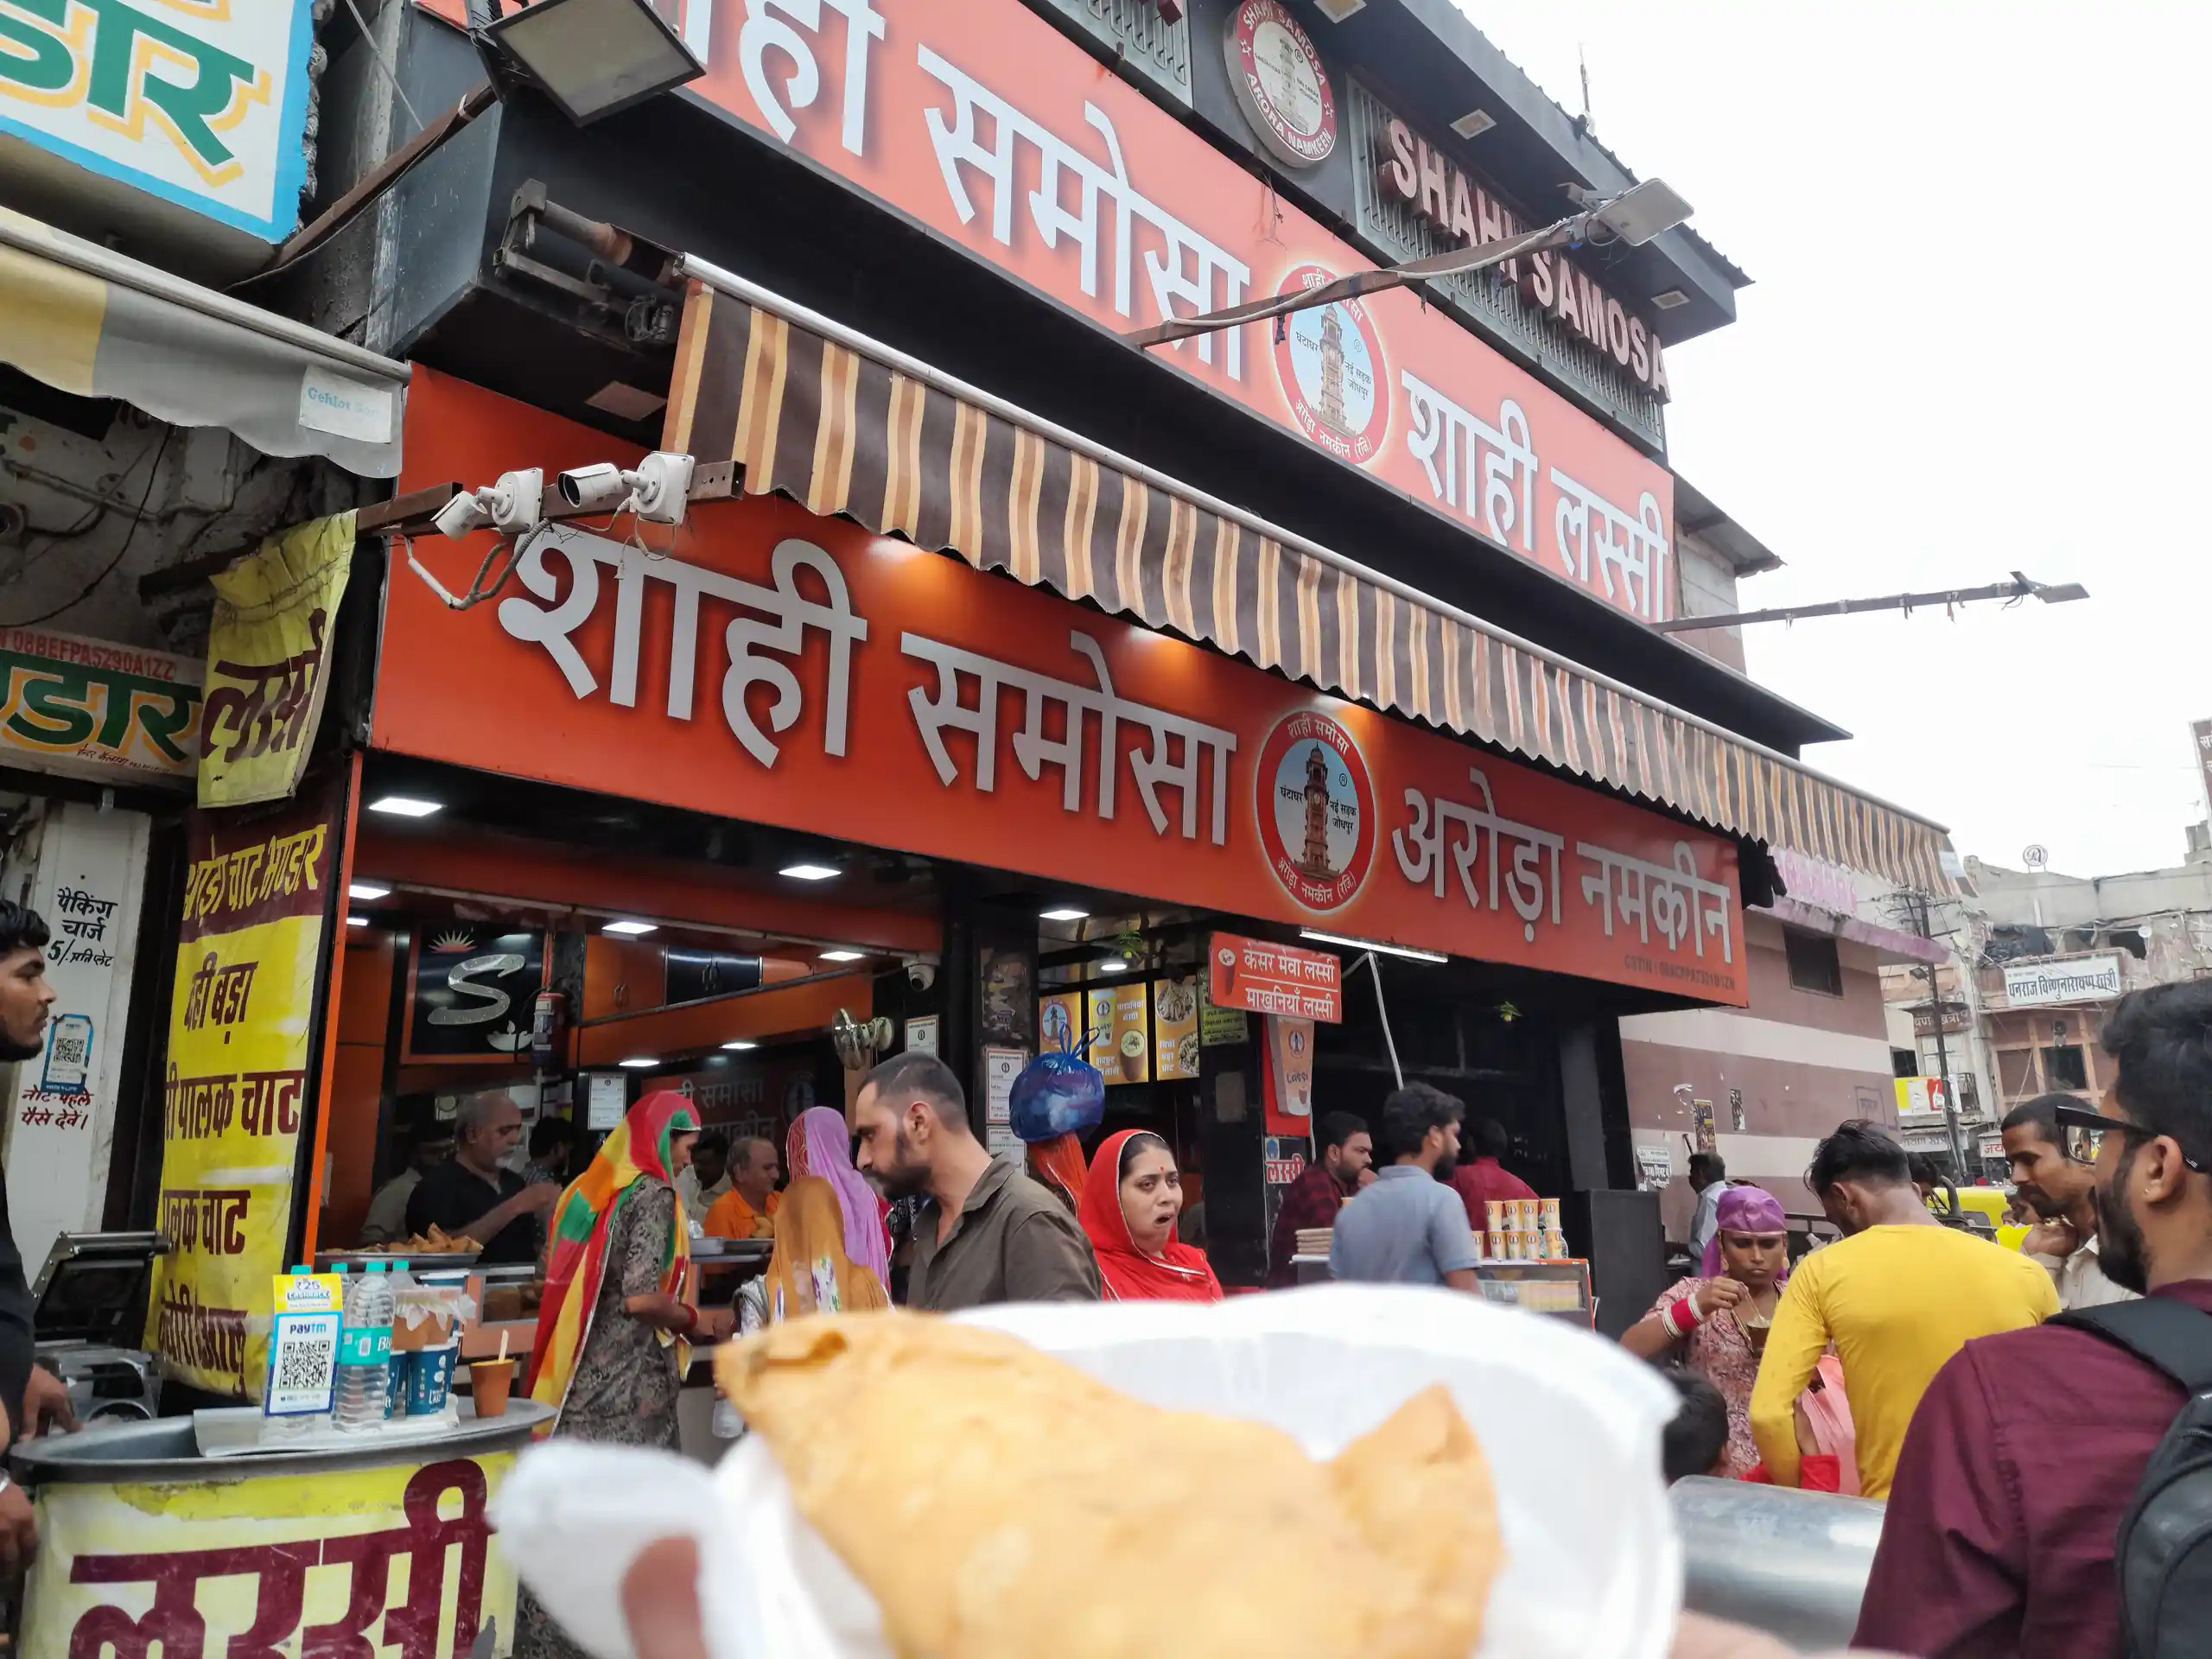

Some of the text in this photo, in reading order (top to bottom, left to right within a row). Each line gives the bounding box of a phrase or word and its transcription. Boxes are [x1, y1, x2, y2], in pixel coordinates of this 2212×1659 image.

[1277, 10, 1325, 86] SAMOSA
[1247, 72, 1332, 156] ARORA NAMKEEN
[918, 42, 1250, 383] समोसा
[1382, 118, 1671, 404] SHAHI SAMOSA
[1295, 398, 1315, 434] अरोड़ा
[1319, 429, 1351, 459] नमकीन
[1402, 369, 1669, 623] शाही लस्सी
[498, 522, 1733, 964] शाही समोसा अरोड़ा नमकीन
[1287, 712, 1351, 757] शाही समोसा
[1280, 784, 1304, 804] घंटाघर
[1330, 798, 1357, 819] नई सड़क
[1332, 817, 1354, 836] जोधपुर
[57, 887, 118, 919] पैकिंग
[229, 842, 266, 912] चाट
[1278, 856, 1298, 890] अरोड़ा
[1301, 880, 1333, 905] नमकीन
[61, 915, 108, 943] चार्ज
[1243, 943, 1336, 984] केसर मेवा लस्सी
[211, 960, 259, 1045] बड़ा
[1302, 991, 1335, 1021] लस्सी
[21, 1104, 54, 1127] पैसे
[178, 1073, 238, 1140] पालक
[241, 1069, 305, 1136] चाट
[201, 1189, 251, 1255] चाट
